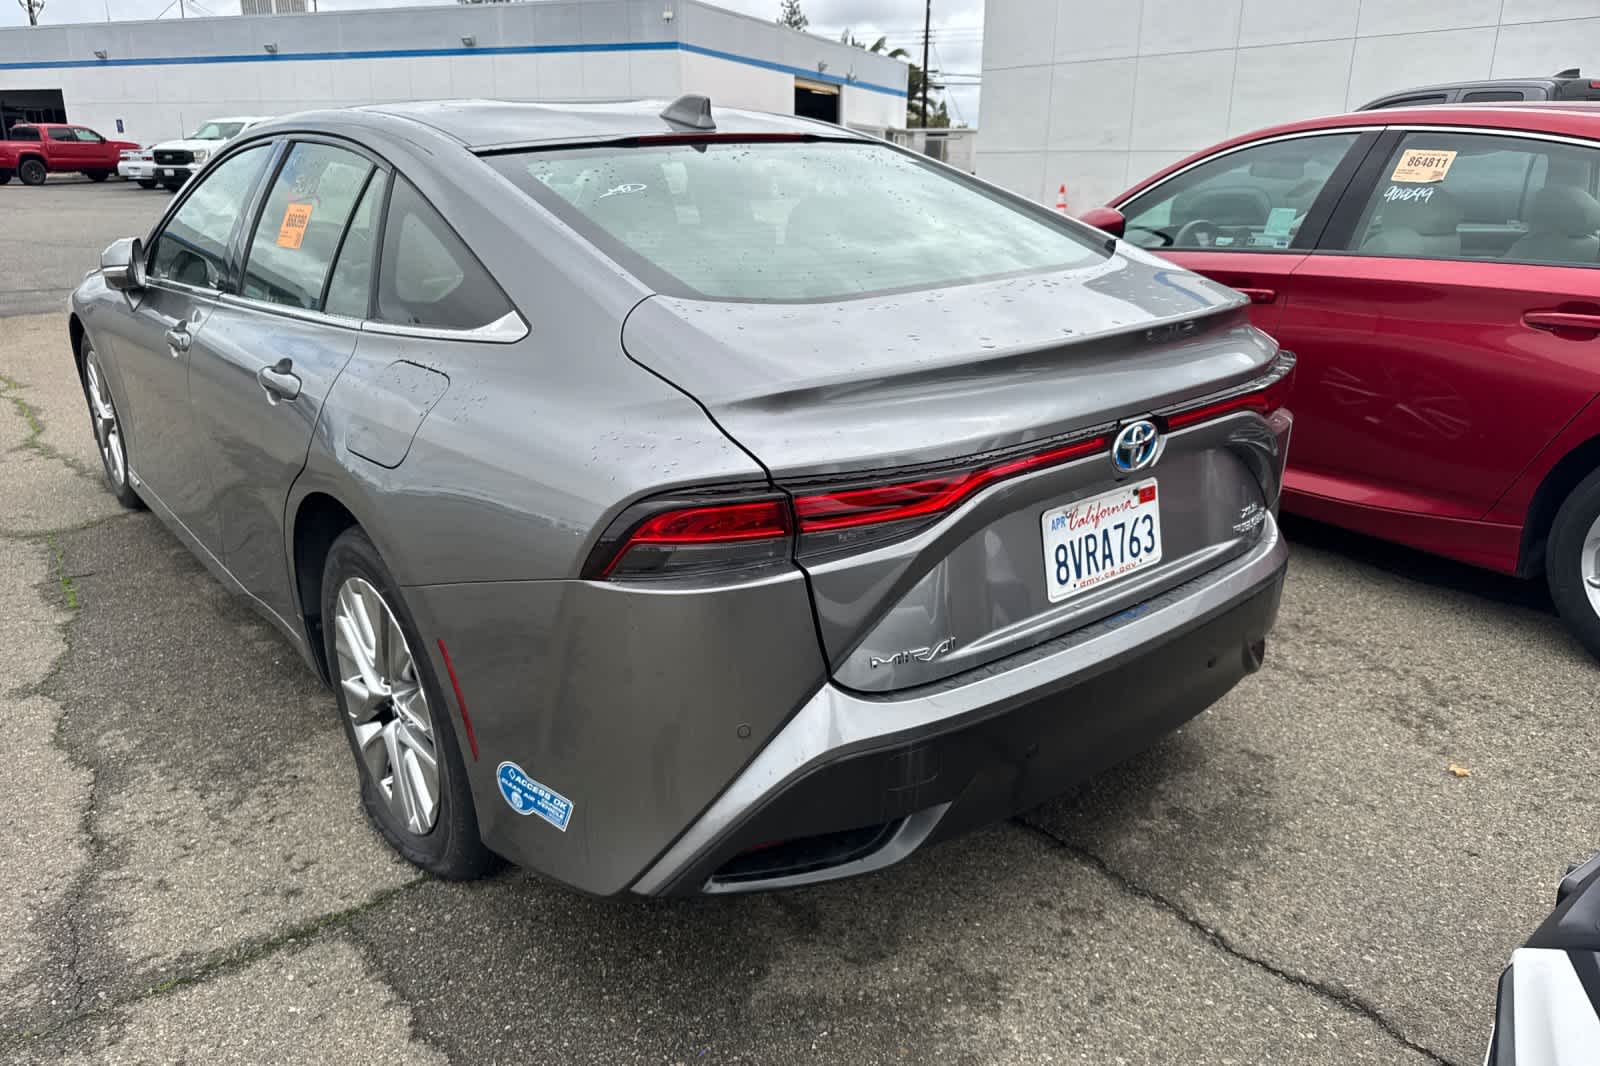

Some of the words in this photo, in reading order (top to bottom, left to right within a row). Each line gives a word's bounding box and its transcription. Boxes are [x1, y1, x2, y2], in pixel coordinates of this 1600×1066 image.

[1407, 156, 1449, 168] 864811
[1051, 516, 1066, 531] APR
[1065, 500, 1138, 531] California
[1055, 513, 1155, 586] 8VRA763
[1079, 561, 1138, 589] dmv.ca.gov
[869, 636, 956, 669] MIRAI
[515, 775, 551, 800] ACCESS
[553, 798, 567, 811] OK
